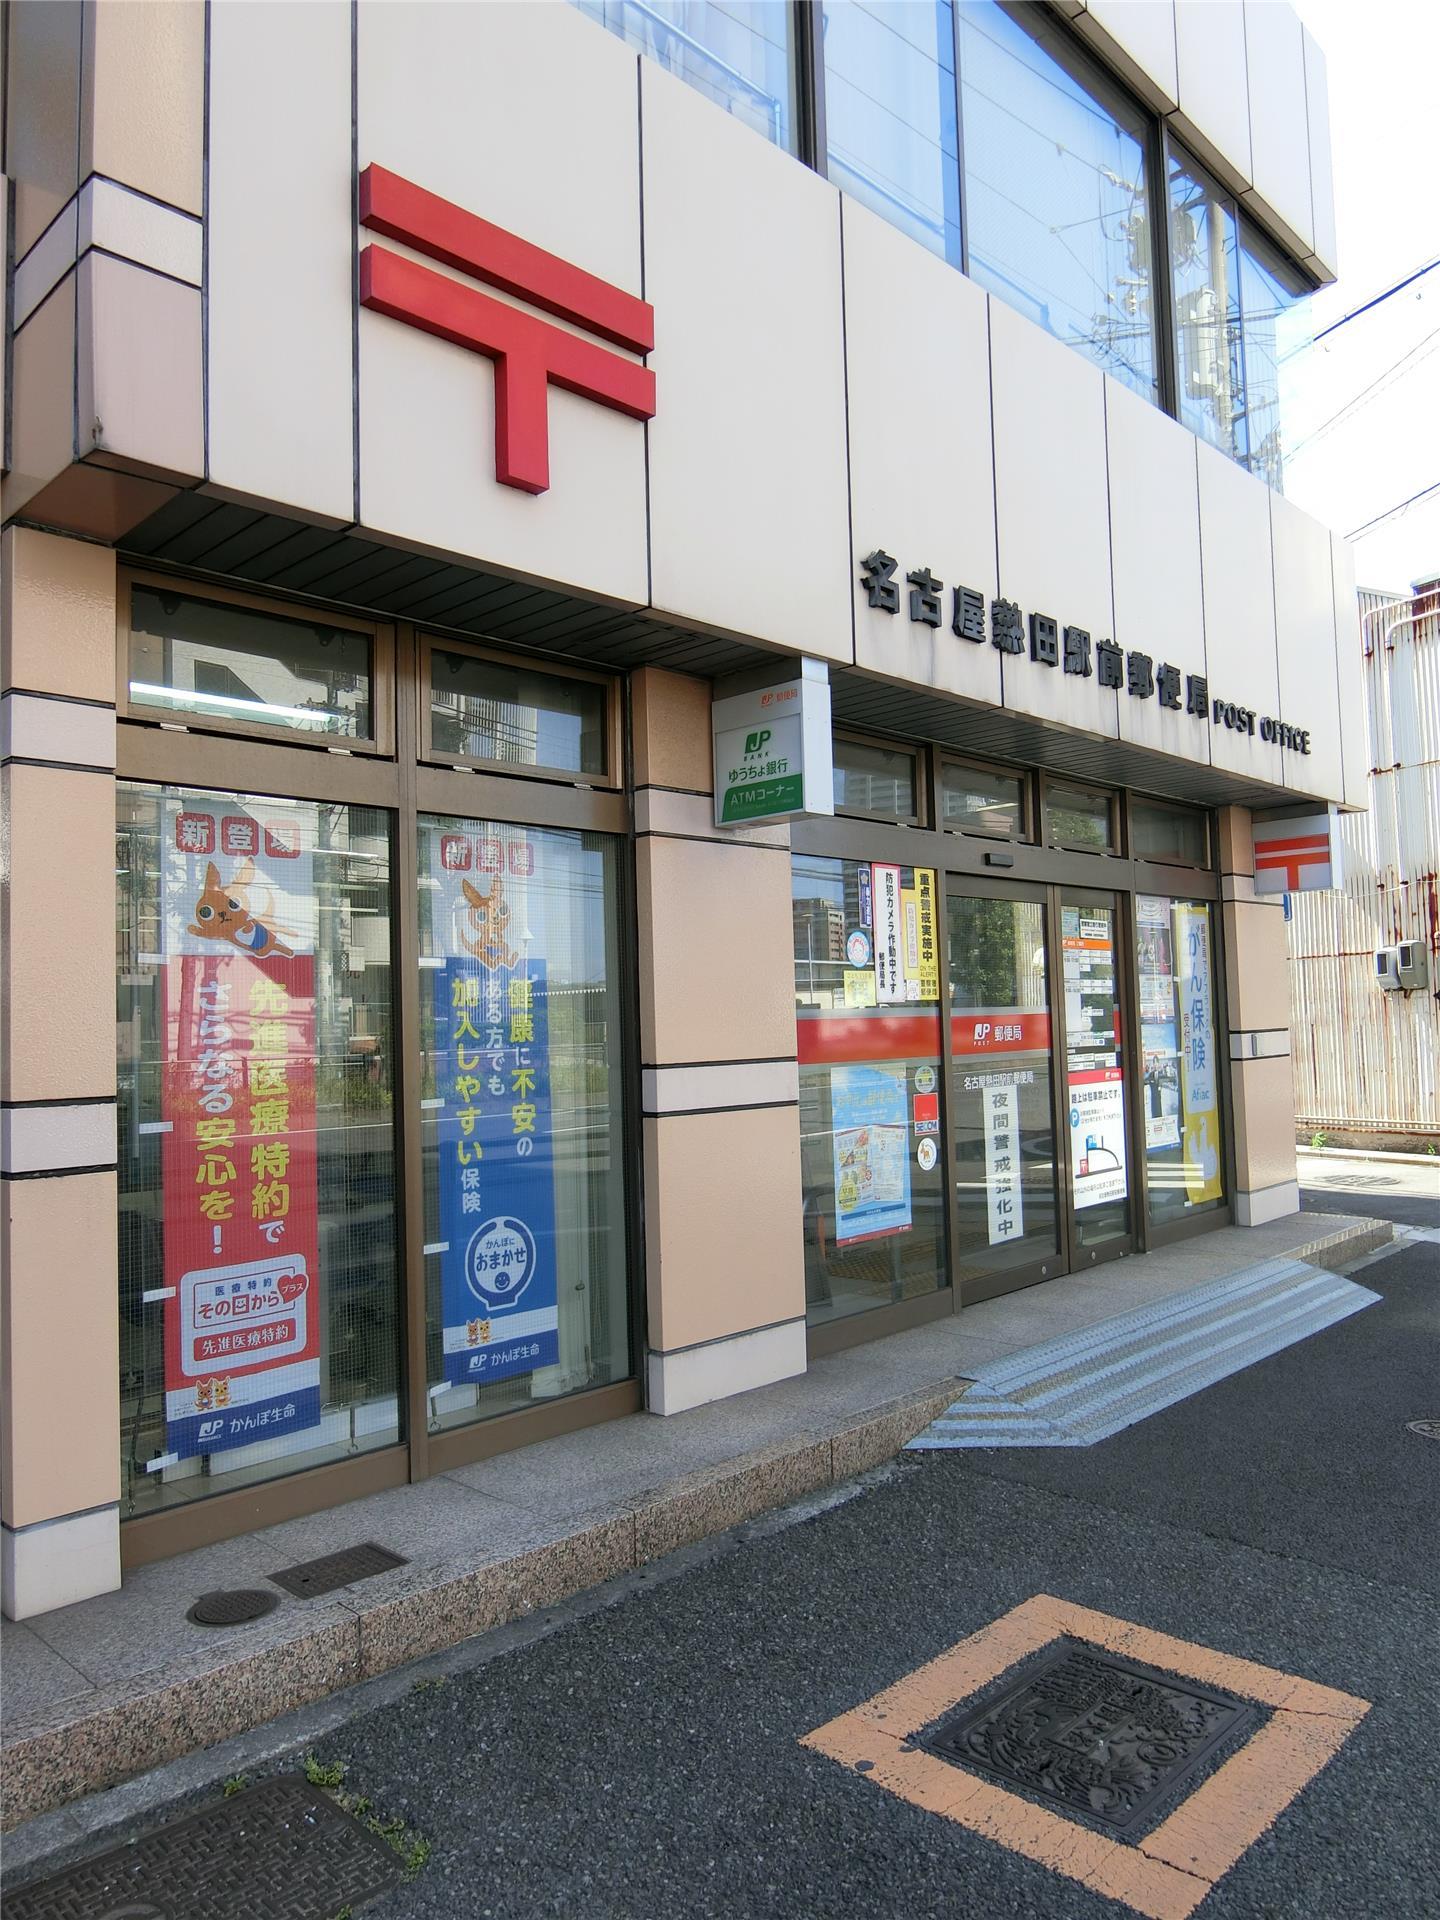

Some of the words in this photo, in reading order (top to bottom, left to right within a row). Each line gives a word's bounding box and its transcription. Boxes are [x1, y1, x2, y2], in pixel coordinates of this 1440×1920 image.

[860, 548, 1208, 719] 名古屋熱田駅前郵便局
[1212, 698, 1256, 736] POST
[1260, 715, 1311, 756] OFFICE
[743, 751, 769, 762] BANK
[745, 730, 772, 755] JP
[729, 758, 789, 784] ゆうちょ銀行
[730, 785, 795, 806] ATMコーナー
[885, 871, 898, 995] 防犯カメラ作動中です
[918, 873, 933, 963] 重点警戒実施中
[1188, 924, 1206, 1072] がん保険
[483, 978, 506, 1097] ある方でも
[974, 1023, 991, 1040] JP
[994, 1025, 1022, 1041] 郵便局
[508, 978, 536, 1157] 健康に不安の
[451, 977, 484, 1214] 加入しやすい保険
[195, 980, 238, 1255] さらなる安心を！
[249, 979, 291, 1244] 先進医療特約で
[915, 1121, 937, 1132] SECOM
[485, 1237, 516, 1250] かんぽに
[475, 1247, 527, 1273] おまかせ
[215, 1277, 272, 1297] 医療特約
[281, 1282, 304, 1294] プラス
[202, 1323, 289, 1357] 先進医療特約
[490, 1343, 540, 1367] かんぽ生命
[198, 1419, 224, 1438] JP
[229, 1402, 296, 1434] かんぽ生命
